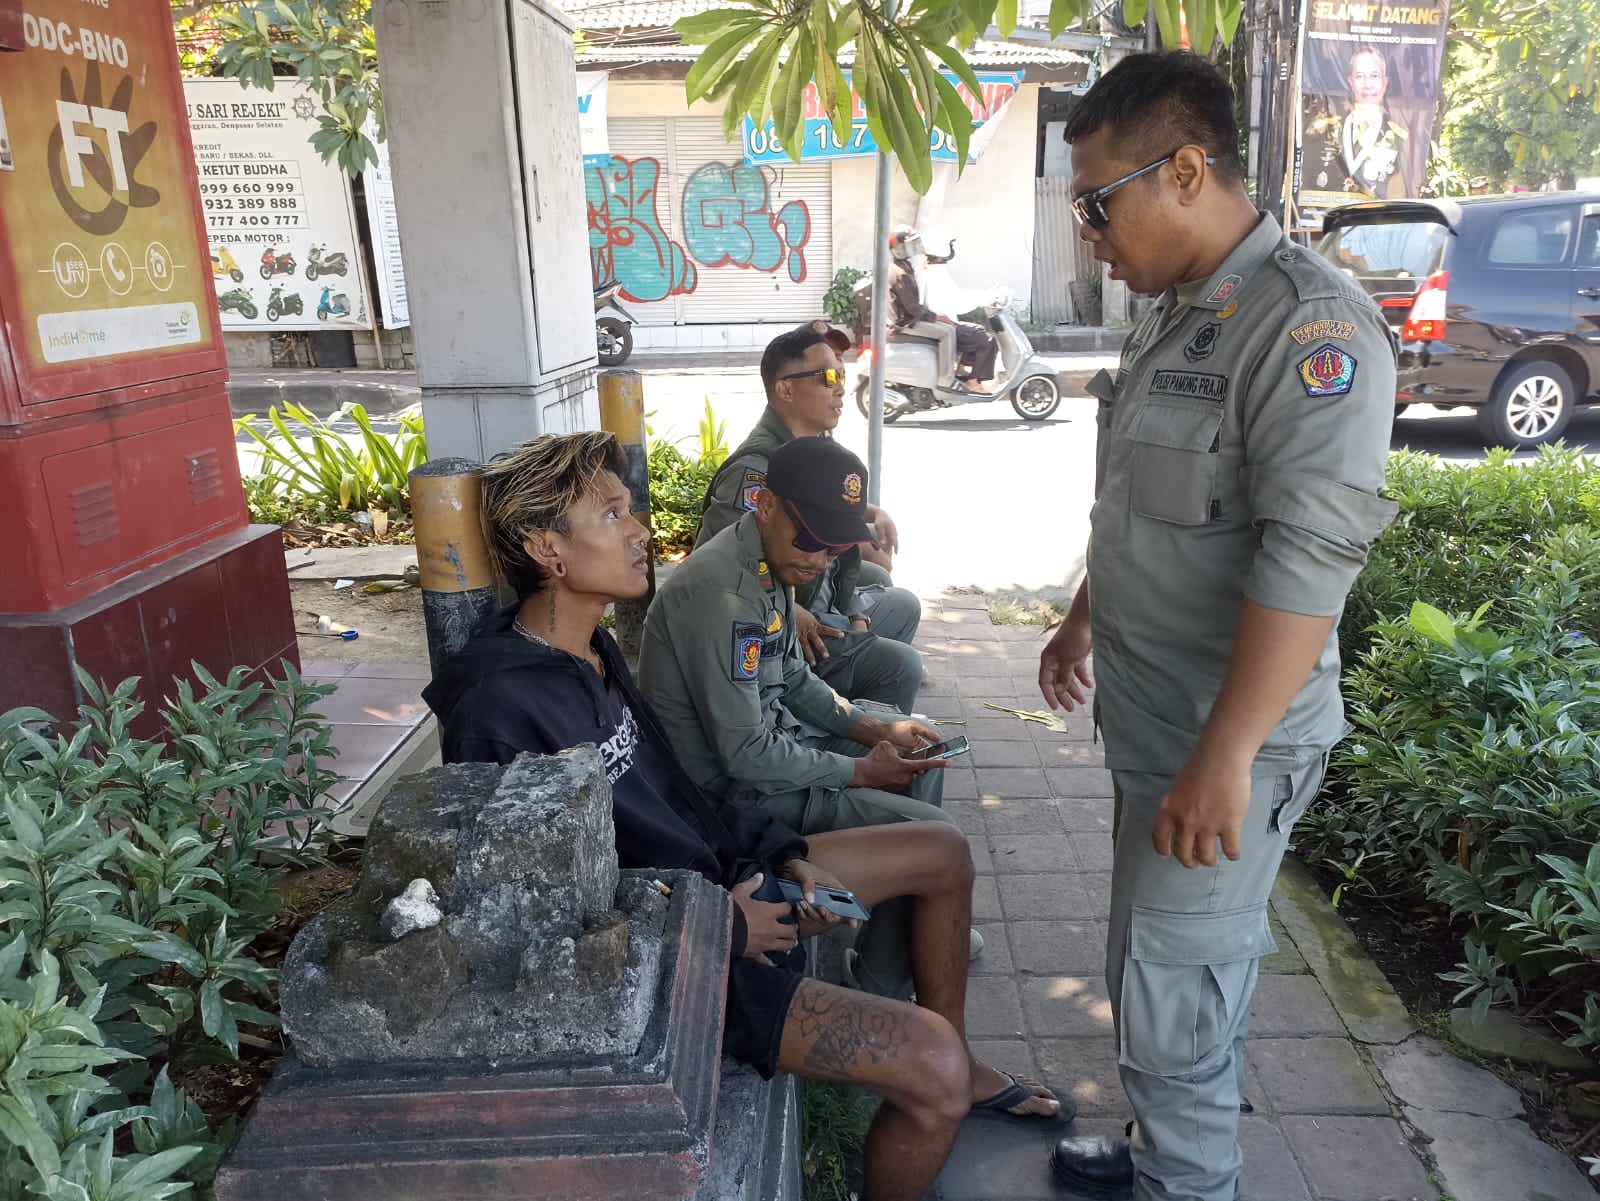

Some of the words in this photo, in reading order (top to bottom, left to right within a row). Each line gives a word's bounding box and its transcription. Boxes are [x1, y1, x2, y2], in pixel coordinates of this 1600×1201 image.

[1312, 1, 1377, 22] SELAMAT
[1380, 6, 1441, 25] DATANG
[23, 12, 129, 69] ODC-BNO
[196, 103, 228, 118] SARI
[220, 122, 254, 131] Denpasar
[56, 99, 129, 190] FT
[203, 164, 240, 176] KETUT
[244, 164, 288, 175] BUDHA
[200, 183, 228, 194] 999
[233, 183, 261, 194] 660
[266, 182, 294, 193] 999
[205, 199, 233, 209] 932
[238, 198, 265, 209] 389
[270, 198, 297, 209] 888
[208, 216, 233, 226] 777
[239, 216, 270, 226] 400
[274, 215, 299, 225] 777
[244, 234, 284, 243] MOTOR
[1170, 375, 1199, 393] PAMONG
[1199, 377, 1226, 400] PRAJA
